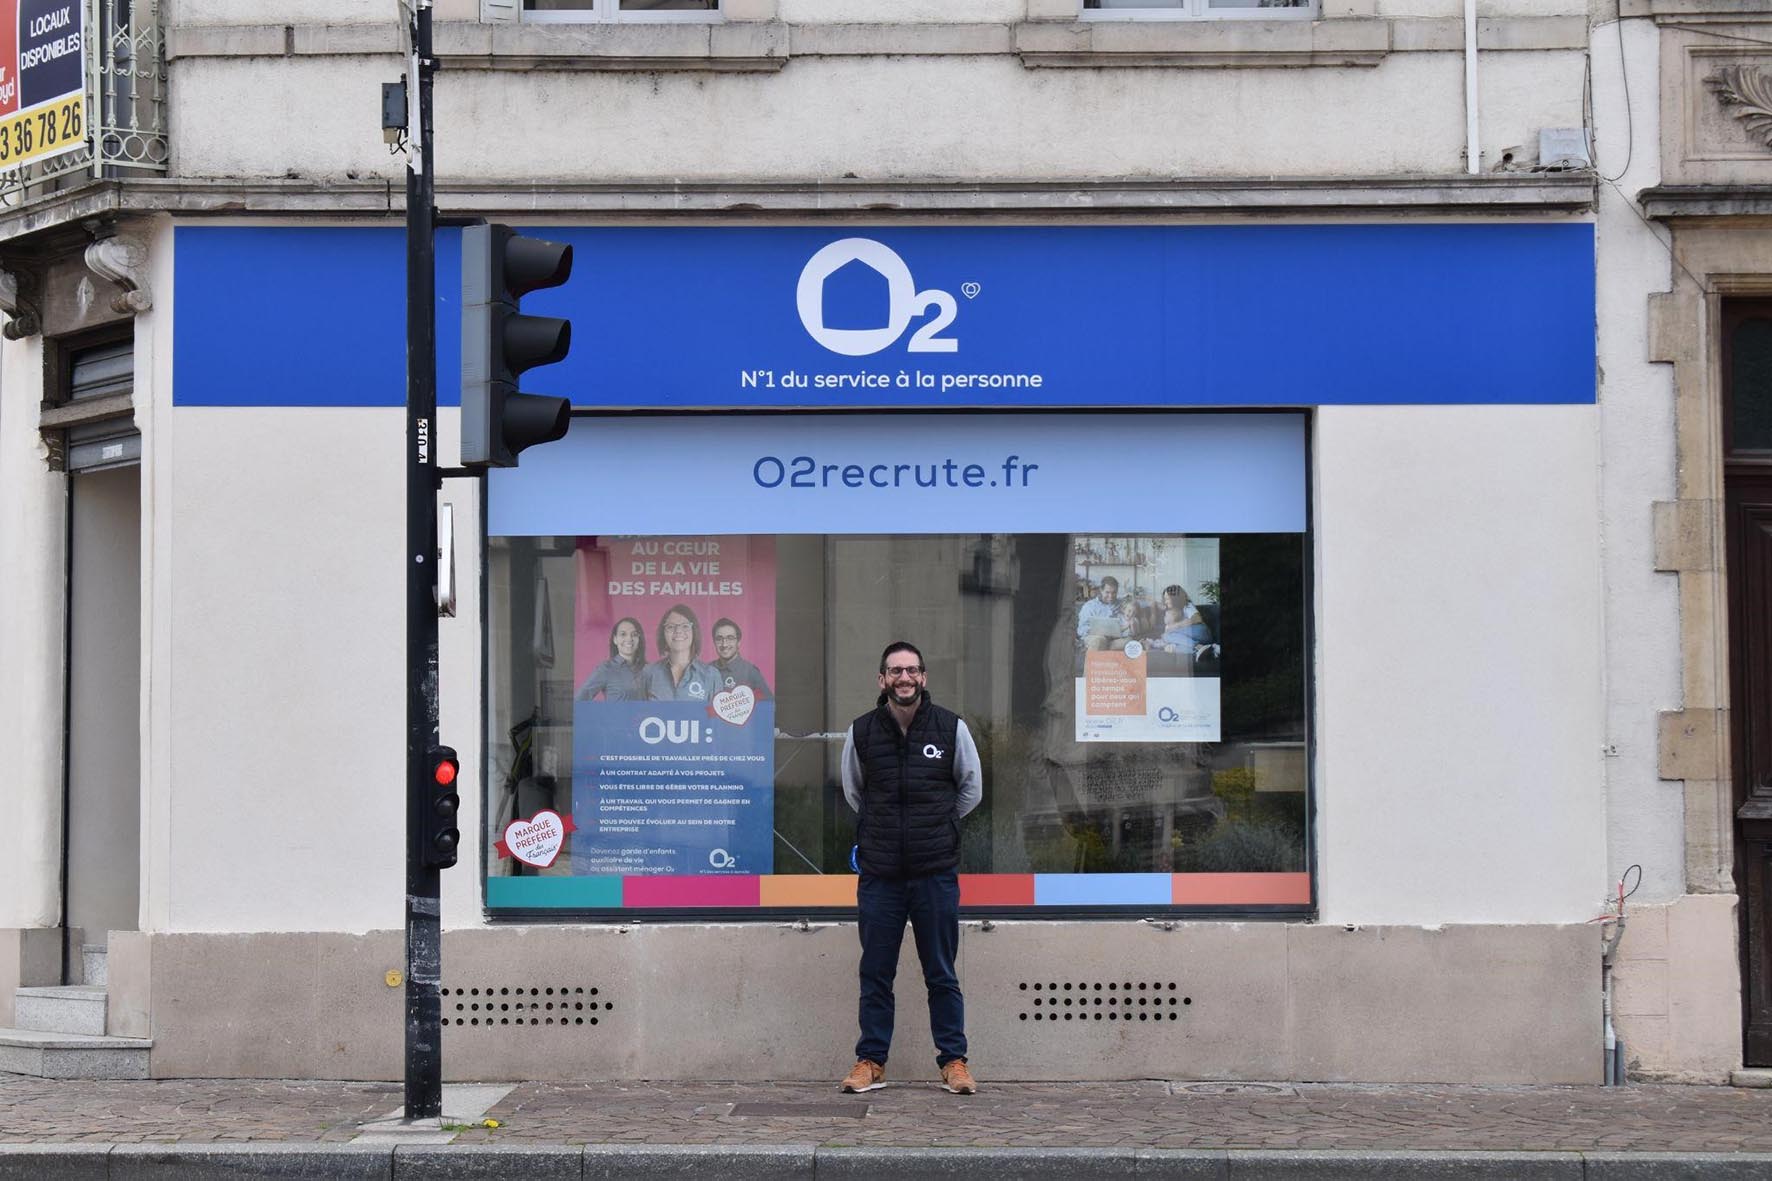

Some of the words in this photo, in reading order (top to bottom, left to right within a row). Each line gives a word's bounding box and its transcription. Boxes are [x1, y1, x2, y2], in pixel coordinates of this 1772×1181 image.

[30, 6, 70, 38] LOCAUX
[20, 32, 81, 71] DISPONIBLES
[14, 118, 33, 156] 36
[38, 109, 57, 148] 78
[62, 101, 81, 140] 26
[796, 237, 958, 356] O2
[741, 370, 775, 388] N°1
[781, 370, 807, 388] du
[815, 370, 889, 388] service
[896, 370, 909, 388] à
[916, 370, 934, 388] la
[942, 372, 1042, 392] personne
[753, 455, 1039, 488] O2recrute.fr
[632, 541, 658, 556] AU
[663, 541, 720, 556] CŒUR
[632, 561, 656, 575] DE
[661, 561, 686, 575] LA
[689, 561, 720, 575] VIE
[608, 581, 645, 596] DES
[650, 581, 743, 596] FAMILLES
[639, 717, 699, 744] OUI
[514, 820, 552, 839] MARQUE
[515, 828, 558, 850] PRÉFÉRÉE
[621, 848, 642, 856] garde
[709, 848, 735, 867] O2
